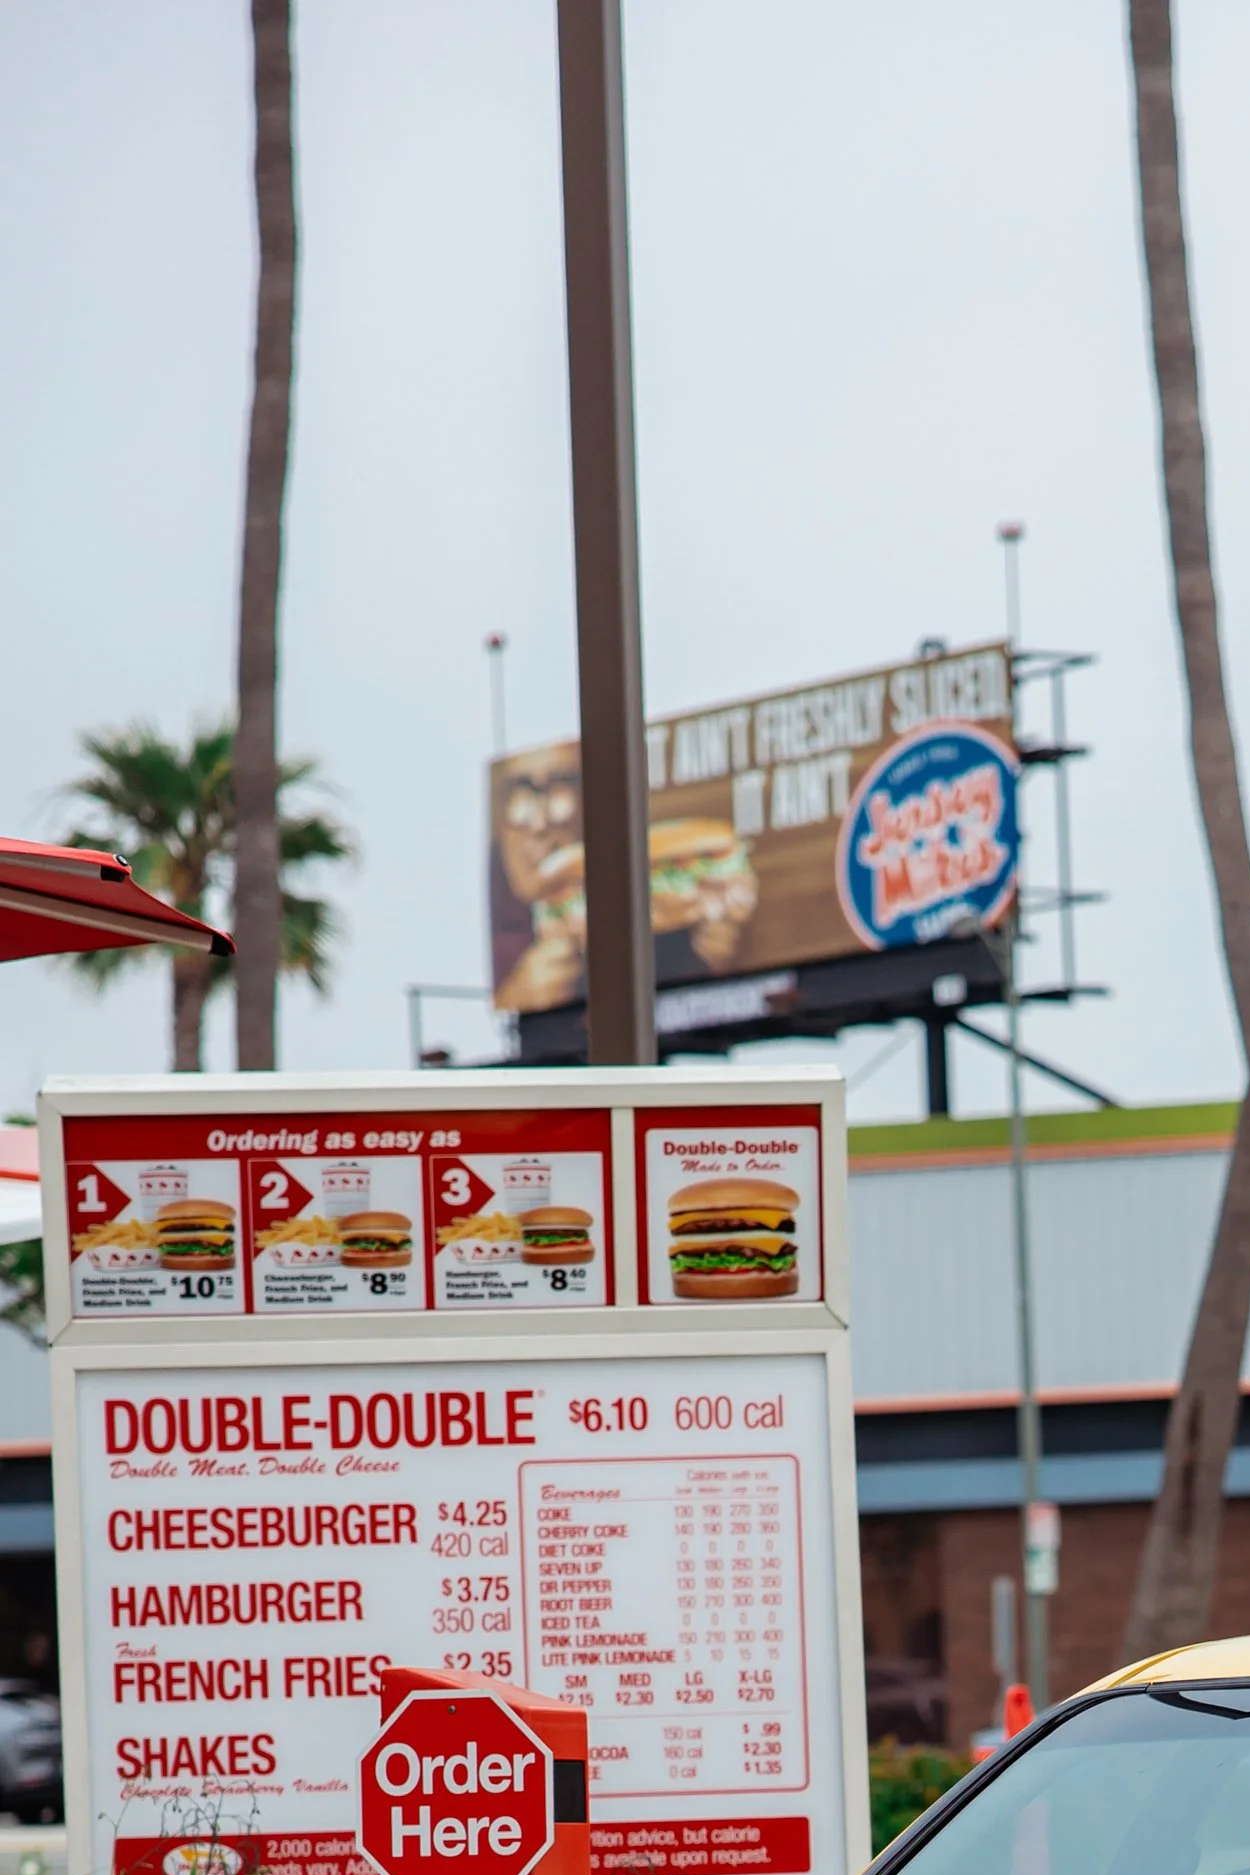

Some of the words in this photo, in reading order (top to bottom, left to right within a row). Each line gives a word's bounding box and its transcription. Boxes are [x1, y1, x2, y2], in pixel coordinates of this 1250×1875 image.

[207, 1129, 319, 1154] Ordering
[324, 1131, 356, 1149] as
[363, 1131, 423, 1152] easy
[429, 1130, 461, 1148] as
[663, 1140, 798, 1156] Double-Double
[680, 1160, 721, 1173] Made
[726, 1162, 738, 1171] to
[77, 1174, 107, 1212] 1
[260, 1171, 289, 1209] 2
[441, 1168, 472, 1206] 3
[104, 1390, 537, 1455] DOUBLE-DOUBLE
[569, 1396, 648, 1432] $6.10
[675, 1395, 732, 1430] 600
[743, 1394, 783, 1429] cal
[109, 1459, 178, 1479] Double
[258, 1456, 326, 1476] Double
[335, 1454, 401, 1477] Cheese
[541, 1484, 620, 1503] Beverages
[538, 1507, 572, 1521] COKE
[107, 1503, 418, 1551] CHEESEBURGER
[438, 1501, 507, 1528] $4.25
[538, 1526, 589, 1539] CHERRY
[594, 1524, 628, 1538] COKE
[431, 1532, 471, 1558] 420
[479, 1531, 509, 1557] cal
[539, 1544, 566, 1558] DIET
[571, 1543, 605, 1557] COKE
[539, 1562, 581, 1576] SEVEN
[585, 1561, 602, 1574] UP
[540, 1581, 558, 1594] DR
[562, 1579, 612, 1593] PEPPER
[110, 1580, 363, 1627] HAMBURGER
[442, 1576, 510, 1602] $3.75
[540, 1599, 573, 1612] ROOT
[579, 1598, 612, 1611] BEER
[432, 1607, 474, 1634] 350
[481, 1606, 511, 1633] cal
[541, 1617, 570, 1630] ICED
[575, 1616, 601, 1629] TEA
[115, 1642, 157, 1658] Fresh
[541, 1635, 572, 1648] PINK
[576, 1633, 647, 1647] LEMONADE
[542, 1653, 569, 1667] LITE
[572, 1652, 601, 1665] PINK
[606, 1649, 675, 1665] LEMONADE
[113, 1659, 269, 1703] FRENCH
[284, 1655, 391, 1698] FRIES
[444, 1651, 512, 1678] $235
[564, 1675, 588, 1689] SM
[619, 1673, 651, 1687] MED
[685, 1671, 703, 1686] LG
[739, 1669, 773, 1684] X-LG
[615, 1691, 654, 1705] $2.30
[676, 1689, 714, 1704] $2.50
[738, 1687, 775, 1702] $2.70
[686, 1726, 702, 1740] cal
[116, 1734, 277, 1779] SHAKES
[590, 1746, 629, 1760] OCOA
[687, 1745, 703, 1759] cal
[744, 1742, 781, 1756] $2.30
[375, 1741, 535, 1797] Order
[669, 1766, 678, 1778] 0
[681, 1766, 697, 1778] cal
[120, 1783, 192, 1800] Chocolate
[203, 1780, 284, 1797] Strawberry
[292, 1779, 349, 1793] Vanilla
[391, 1805, 522, 1858] Here
[627, 1828, 679, 1847] advice,
[683, 1827, 708, 1844] but
[711, 1825, 760, 1843] calorie
[267, 1839, 310, 1860] 2,000
[603, 1849, 666, 1868] available
[670, 1850, 708, 1869] upon
[711, 1846, 771, 1868] request.
